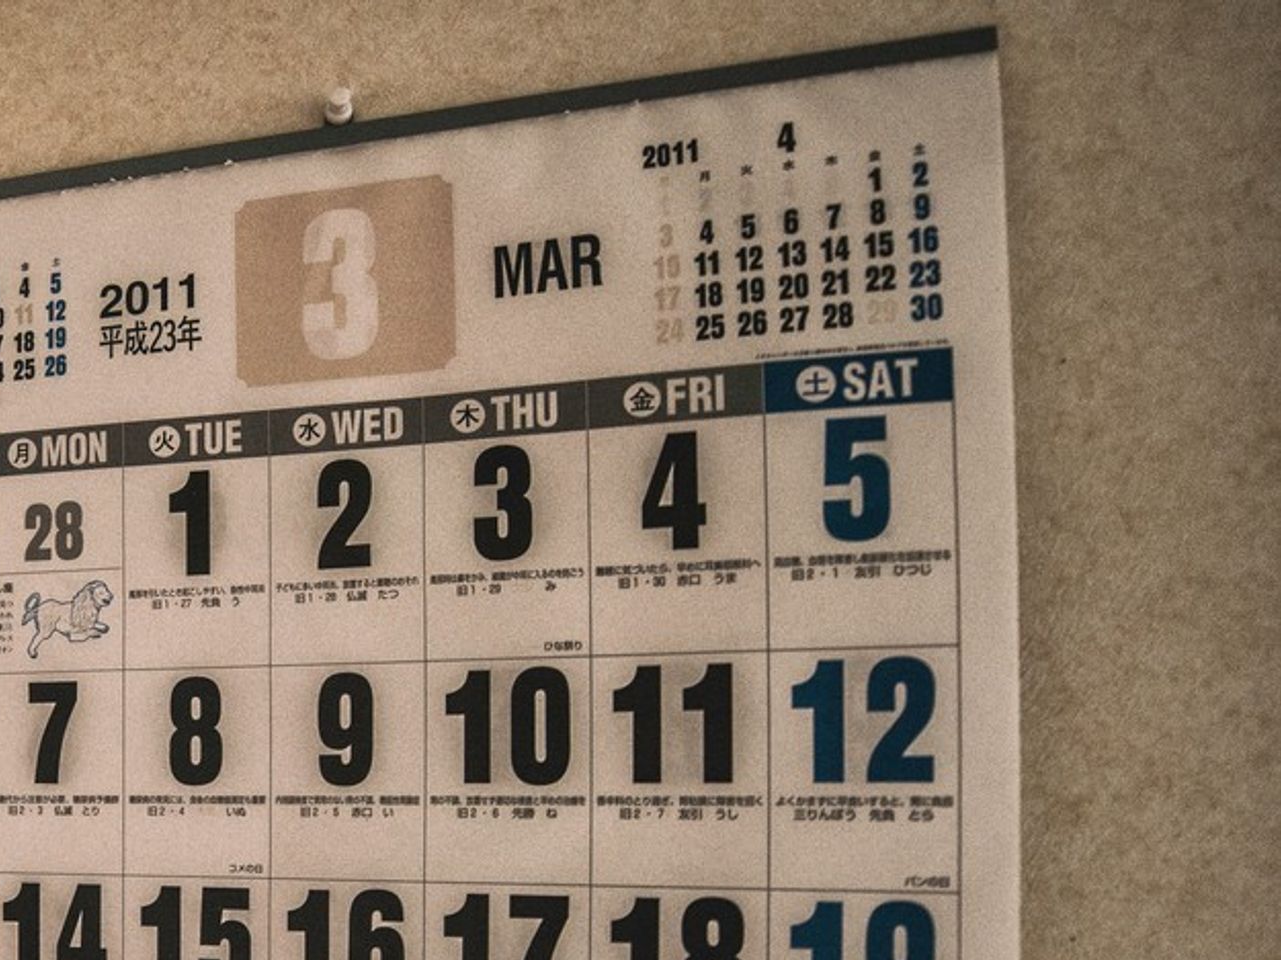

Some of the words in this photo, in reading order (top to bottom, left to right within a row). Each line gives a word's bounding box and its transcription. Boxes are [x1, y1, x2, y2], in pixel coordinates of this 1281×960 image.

[643, 139, 698, 169] 2011
[777, 122, 796, 152] 4
[868, 167, 881, 192] 1
[913, 161, 929, 187] 2
[700, 220, 714, 244] 4
[741, 214, 756, 239] 5
[784, 209, 799, 234] 6
[826, 203, 841, 230] 7
[870, 199, 886, 225] 8
[914, 193, 930, 220] 9
[494, 234, 602, 299] MAR
[694, 250, 719, 276] 11
[735, 245, 763, 272] 12
[778, 240, 807, 267] 13
[820, 236, 850, 263] 14
[864, 231, 894, 258] 15
[908, 226, 939, 254] 16
[19, 277, 30, 298] 4
[50, 272, 61, 294] 5
[100, 273, 195, 319] 2011
[302, 207, 379, 359] 3
[695, 281, 723, 308] 18
[737, 277, 765, 304] 19
[779, 273, 809, 300] 20
[822, 269, 849, 296] 21
[865, 264, 896, 292] 22
[910, 259, 941, 288] 23
[46, 300, 66, 322] 12
[696, 314, 725, 341] 25
[738, 309, 767, 337] 26
[780, 306, 809, 333] 27
[823, 302, 853, 329] 28
[910, 293, 943, 322] 30
[14, 331, 34, 353] 18
[45, 327, 66, 349] 19
[100, 315, 202, 359] 平成23年
[14, 358, 35, 381] 25
[45, 354, 67, 377] 26
[843, 358, 918, 401] SAT
[491, 391, 558, 431] THU
[666, 374, 725, 415] FRI
[184, 420, 241, 457] TUE
[331, 407, 403, 444] WED
[41, 431, 107, 466] MON
[26, 502, 83, 560] 28
[169, 470, 210, 576] 1
[318, 459, 372, 570] 2
[474, 445, 532, 561] 3
[642, 431, 707, 550] 4
[823, 415, 890, 542] 5
[29, 681, 77, 784] 7
[170, 677, 222, 786] 8
[318, 672, 373, 786] 9
[446, 666, 570, 785] 10
[613, 663, 733, 783] 11
[792, 656, 935, 783] 12
